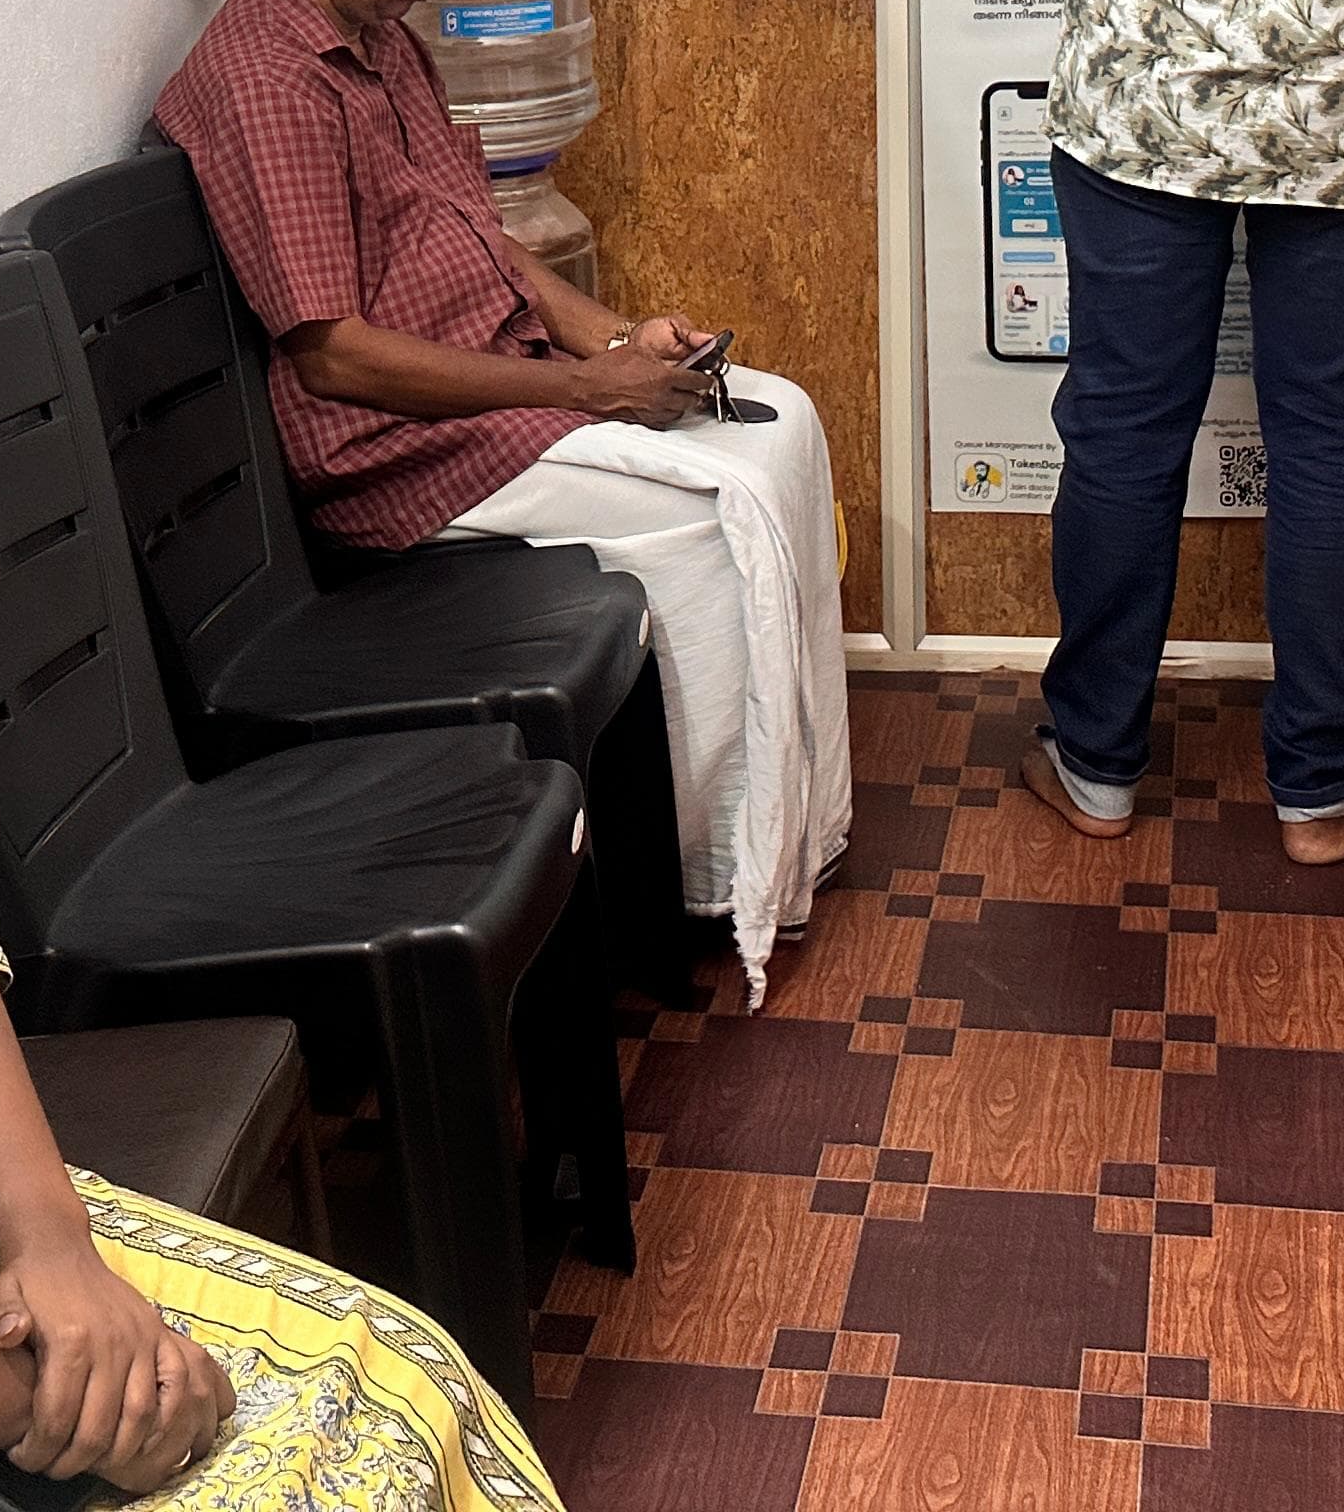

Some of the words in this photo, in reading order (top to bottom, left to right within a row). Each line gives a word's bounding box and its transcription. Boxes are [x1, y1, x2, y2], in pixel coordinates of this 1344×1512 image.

[954, 440, 983, 448] Queue
[985, 441, 1044, 451] Management
[1046, 442, 1057, 451] By
